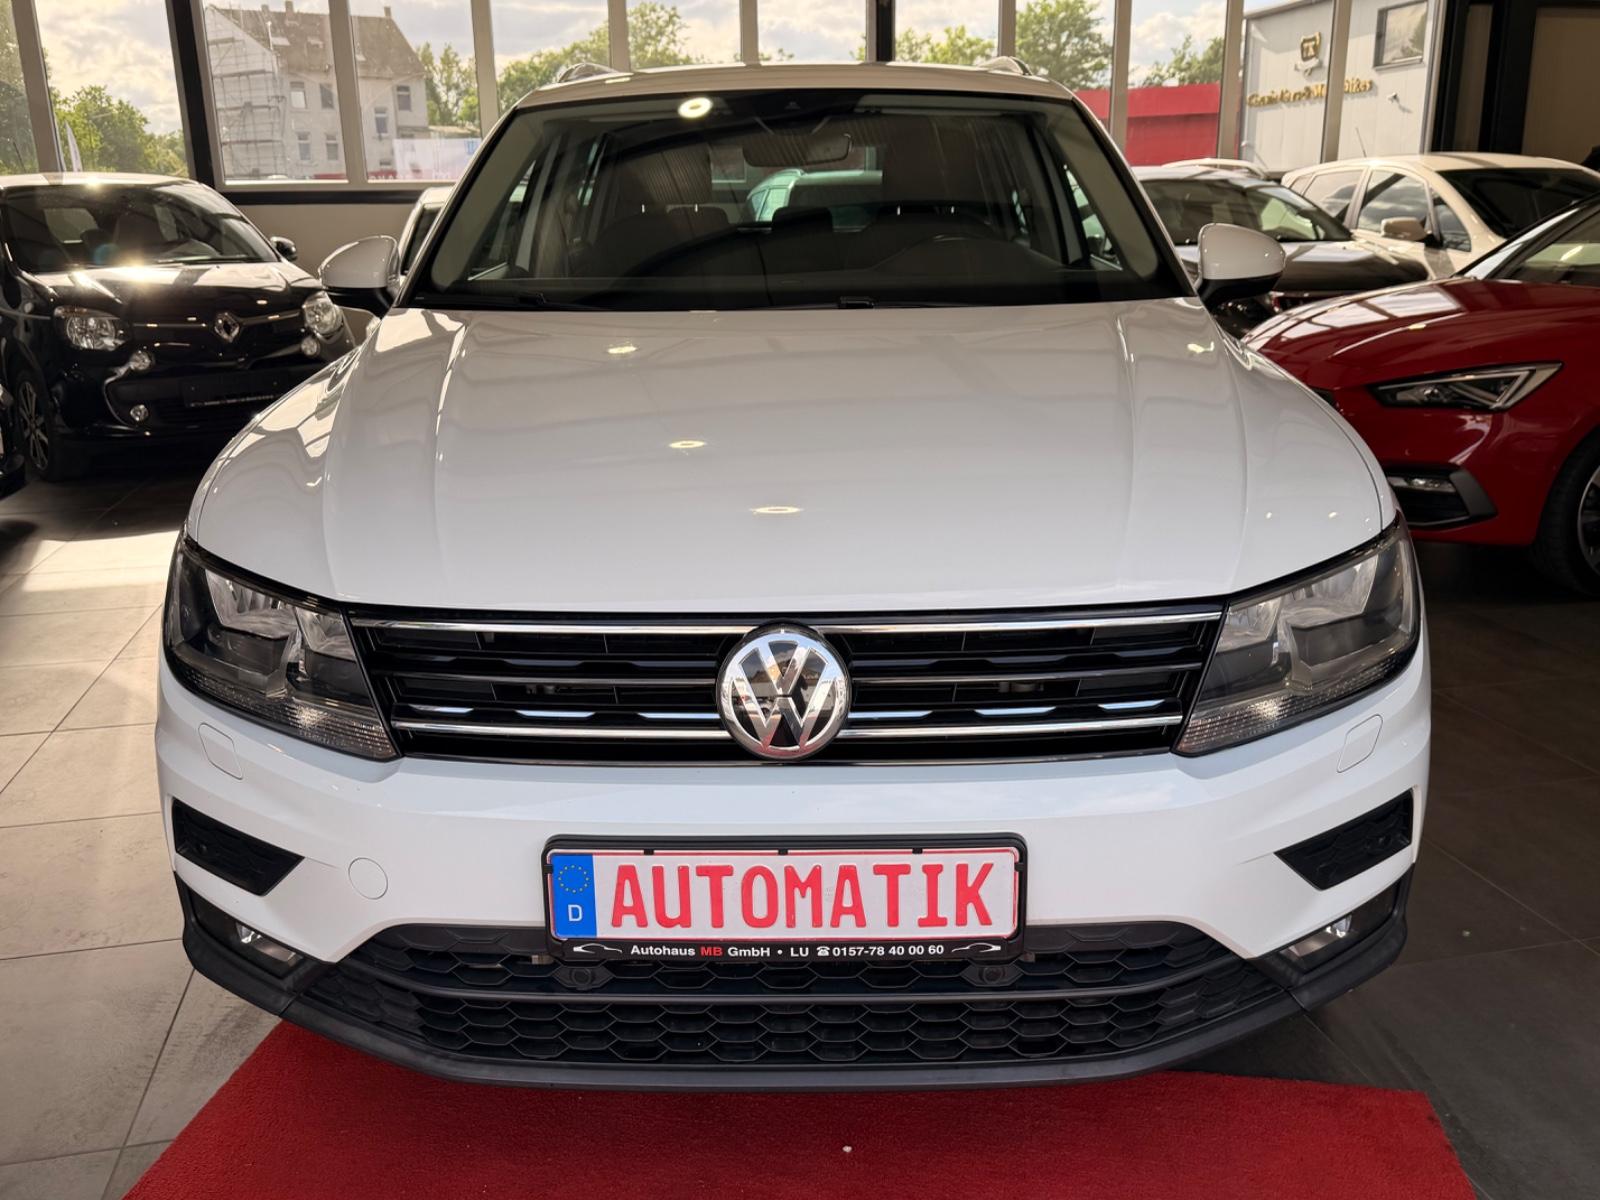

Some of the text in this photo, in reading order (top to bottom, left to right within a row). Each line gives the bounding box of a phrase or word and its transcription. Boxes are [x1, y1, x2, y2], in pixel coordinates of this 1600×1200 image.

[567, 863, 994, 928] D AUTOMATIK
[630, 944, 944, 958] Autohaus MB GmbH LU 0157-78 40 00 60
